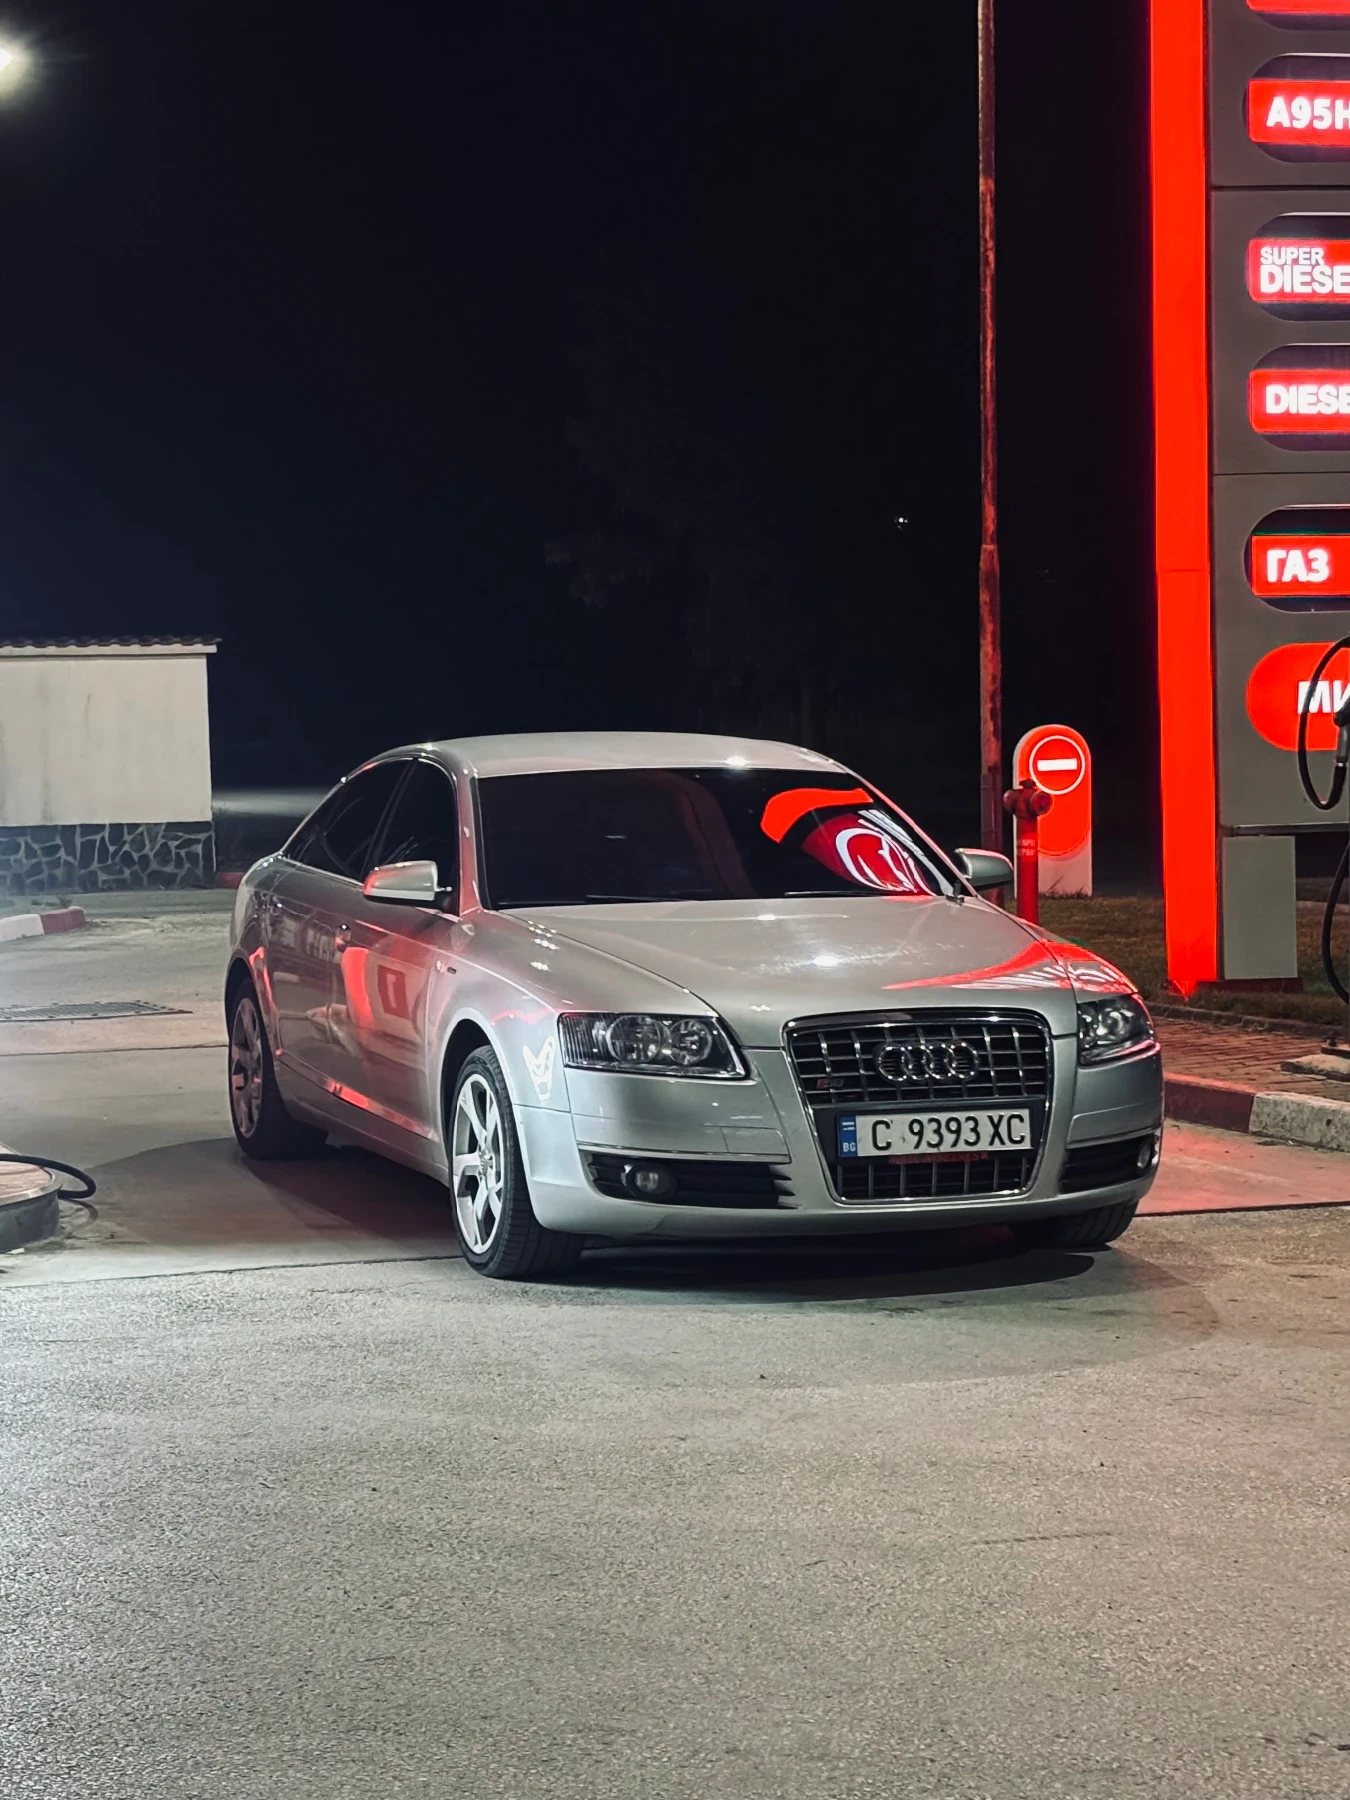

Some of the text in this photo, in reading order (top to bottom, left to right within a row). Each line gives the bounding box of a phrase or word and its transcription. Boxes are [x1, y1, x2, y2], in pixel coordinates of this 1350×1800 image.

[1260, 247, 1324, 265] SUPER
[1260, 264, 1350, 294] DIESE
[1267, 549, 1330, 583] ГАЗ
[842, 1141, 857, 1153] BG
[871, 1113, 1026, 1151] C 9393 XC
